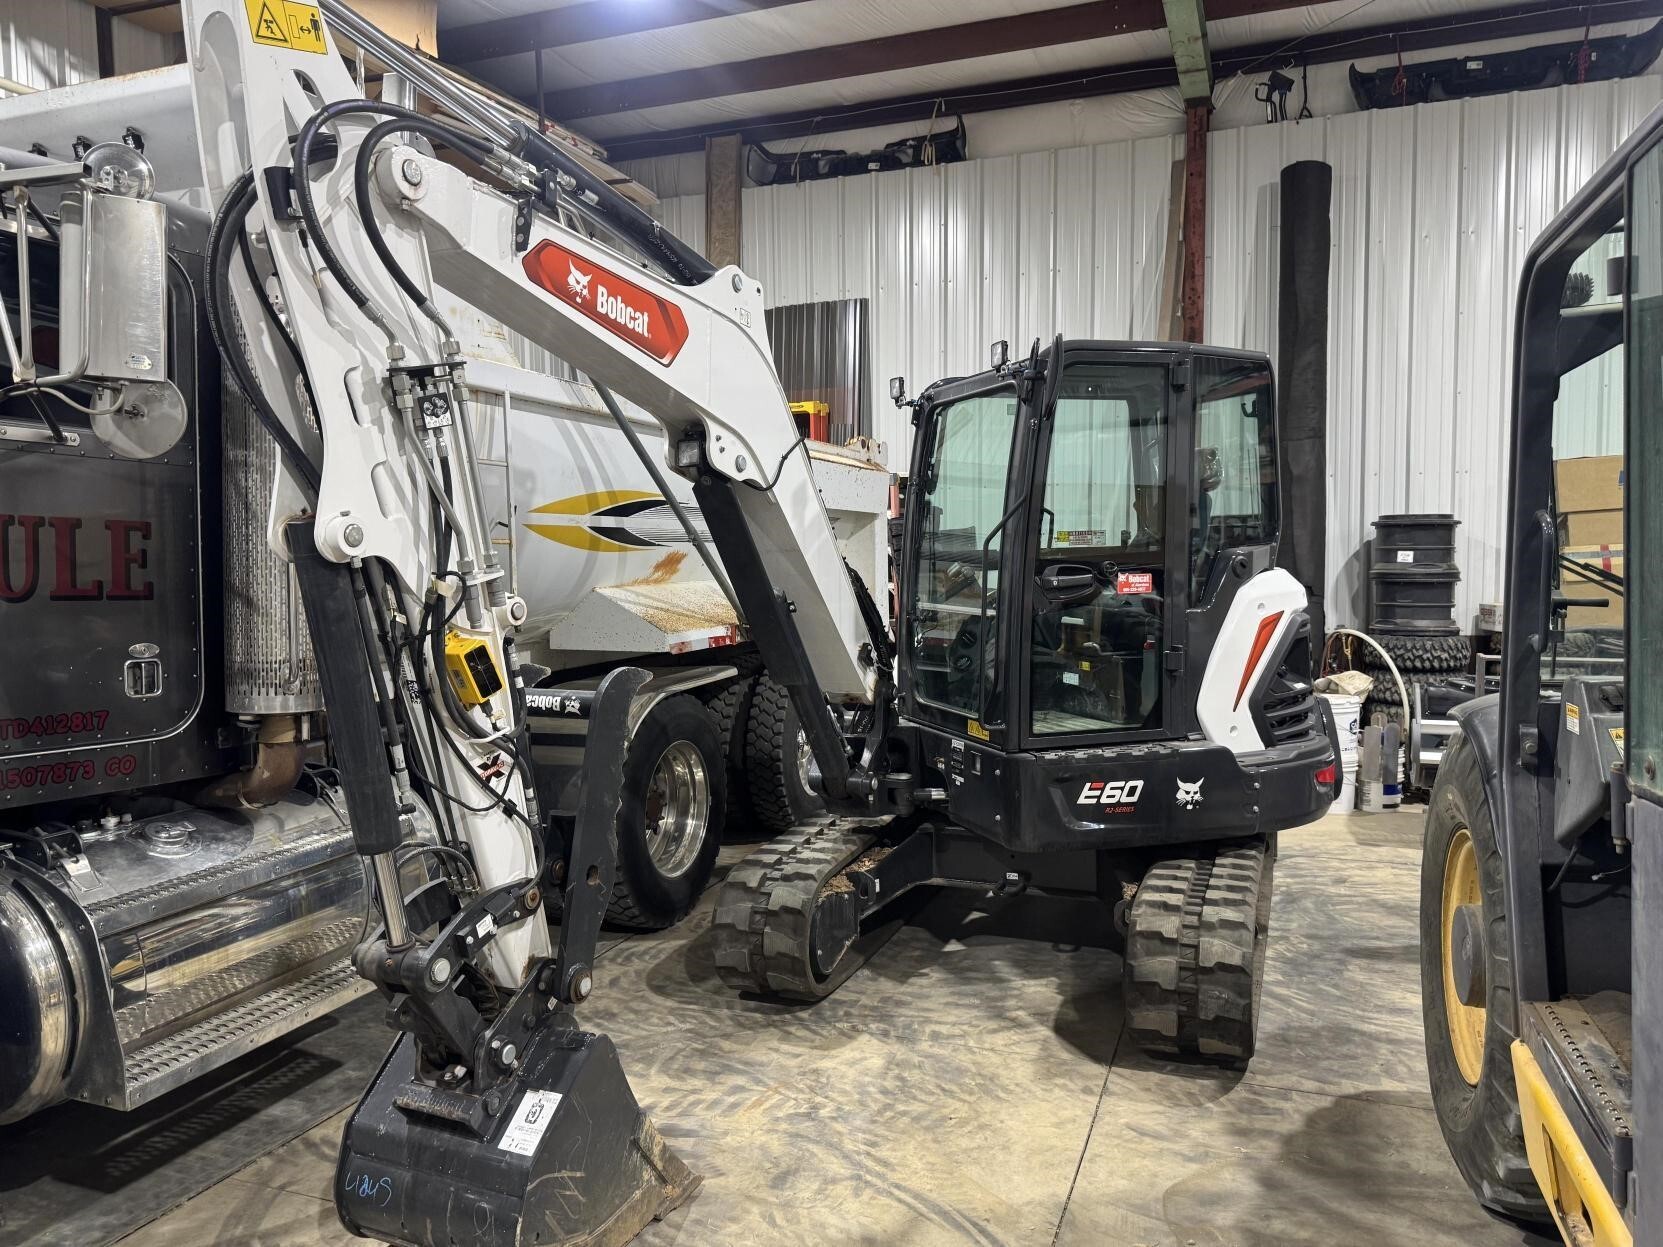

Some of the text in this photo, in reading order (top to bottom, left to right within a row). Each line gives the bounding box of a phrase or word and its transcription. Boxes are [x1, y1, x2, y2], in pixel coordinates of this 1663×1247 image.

[596, 284, 650, 338] Bobcat
[0, 514, 154, 603] ULE
[525, 694, 561, 712] Bobca
[0, 710, 109, 740] TD412817
[104, 754, 137, 777] CO
[1076, 780, 1144, 804] E60
